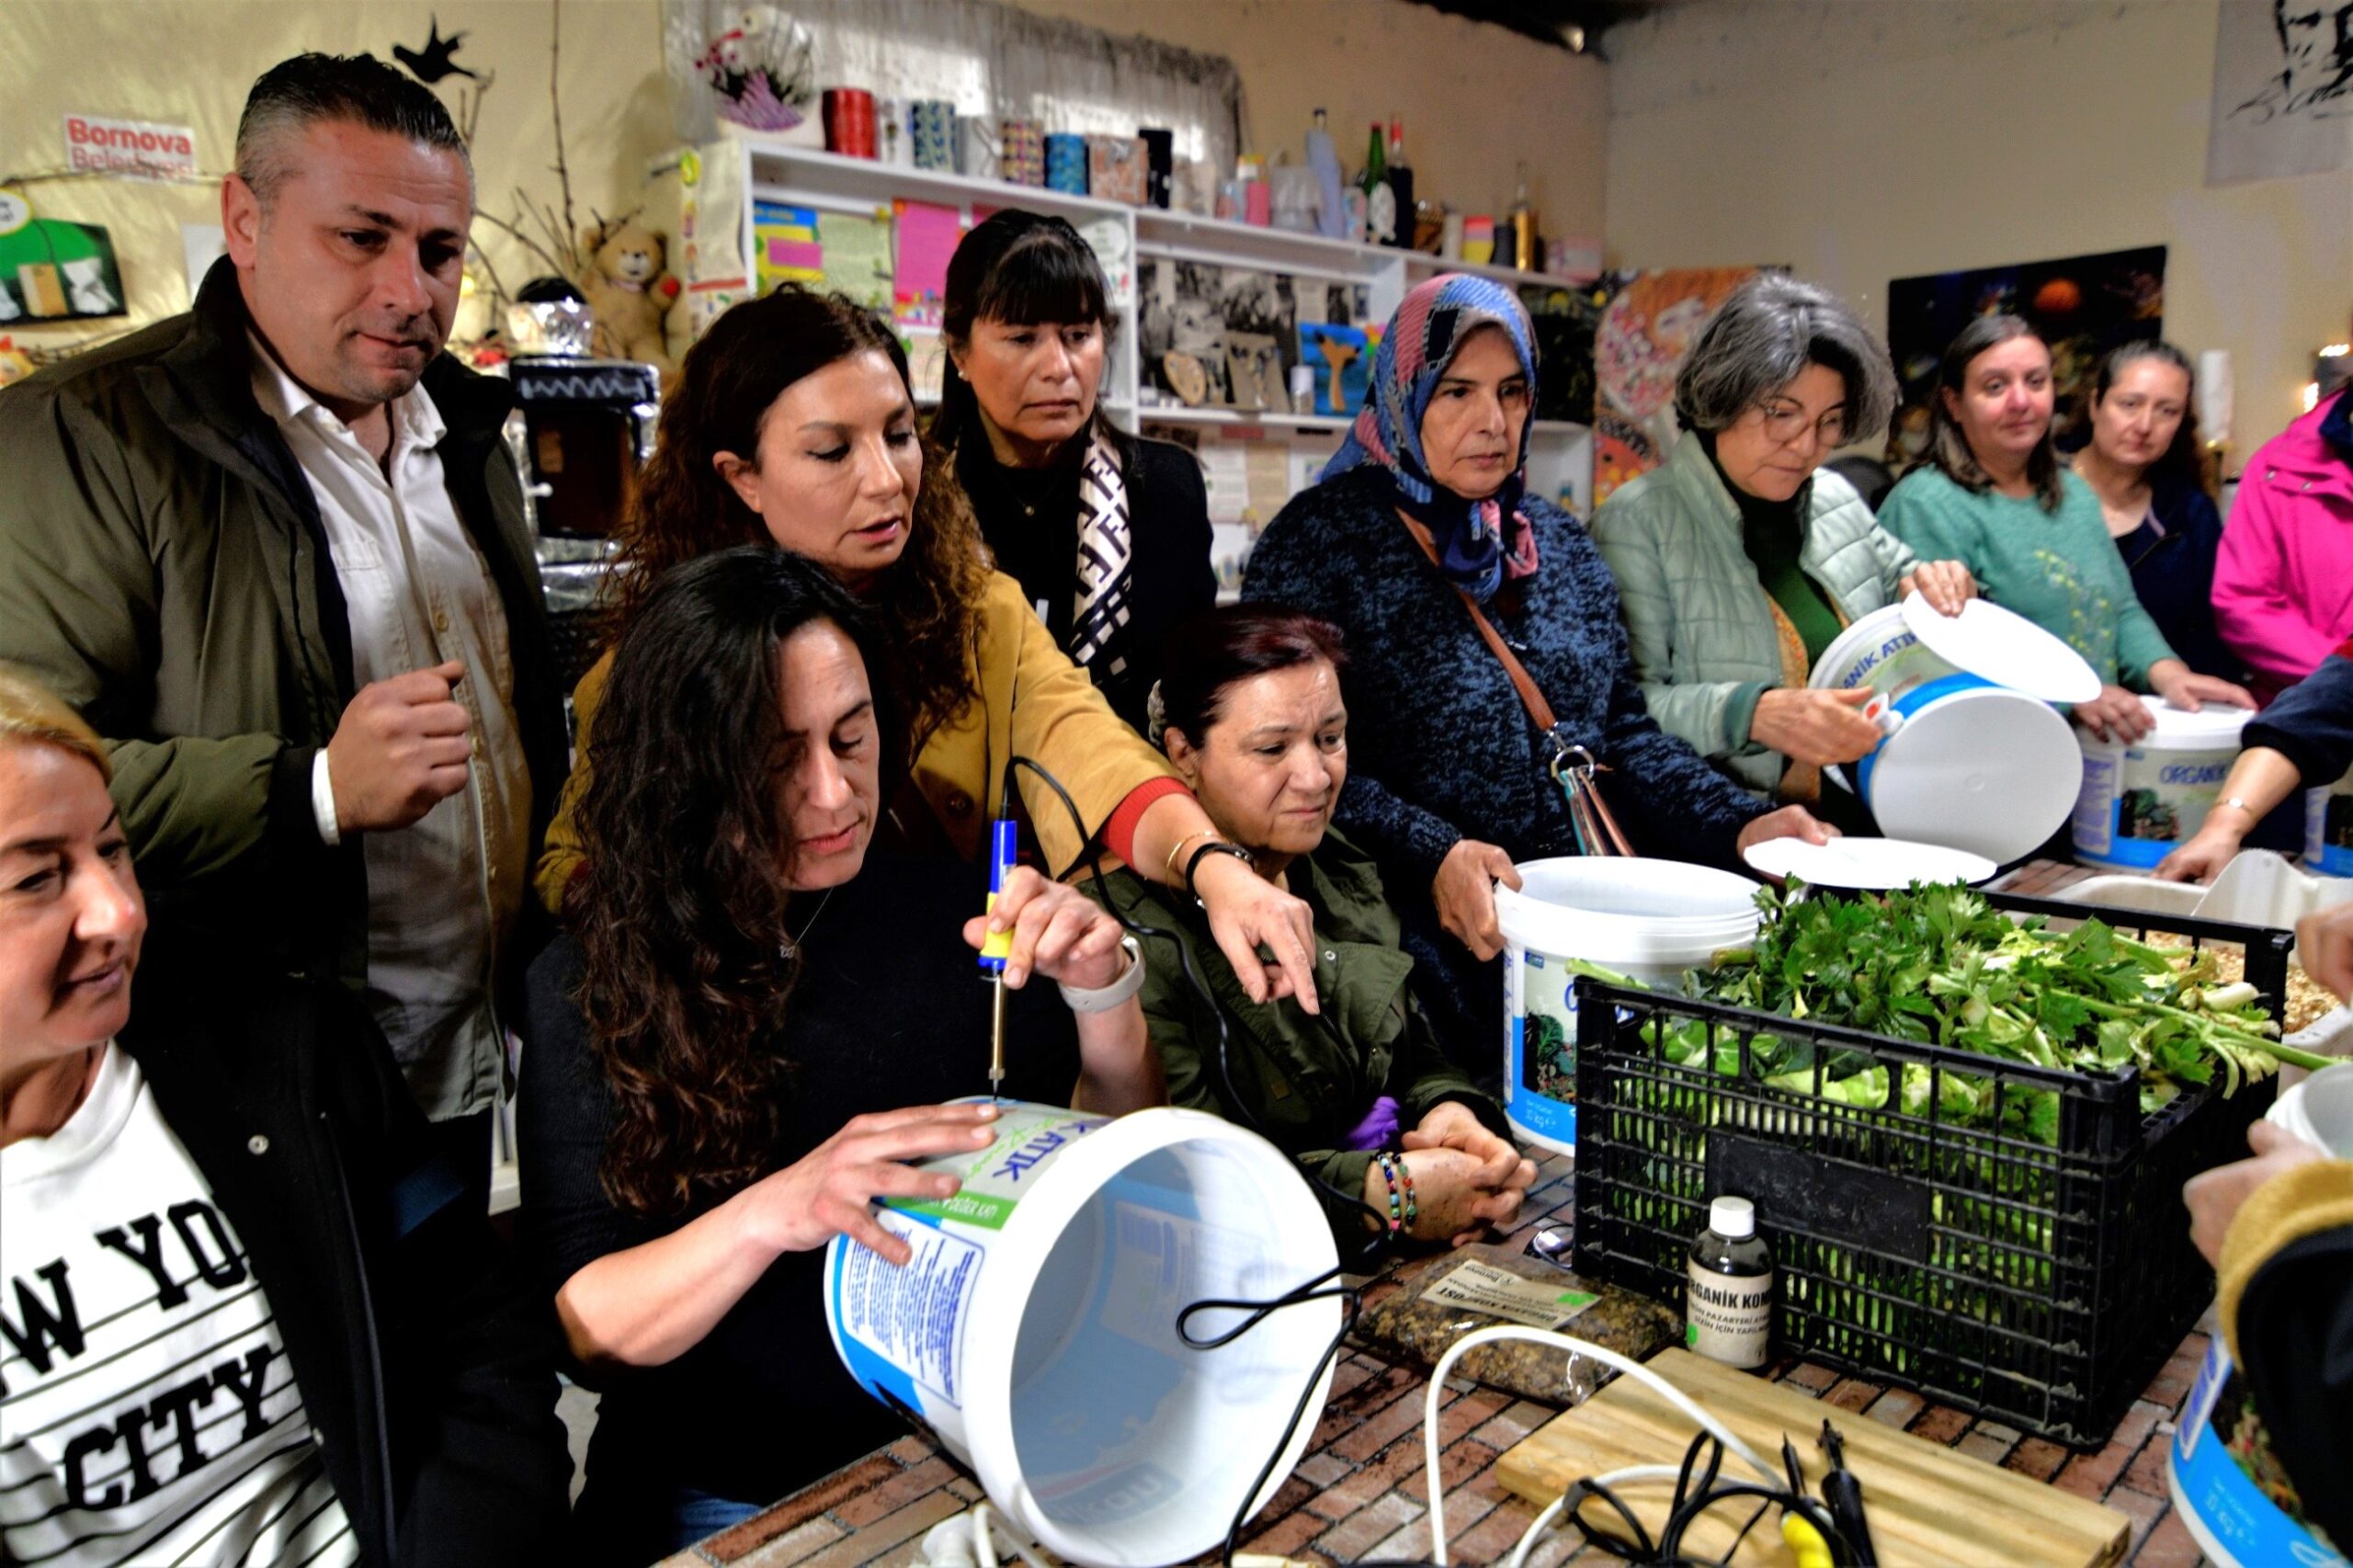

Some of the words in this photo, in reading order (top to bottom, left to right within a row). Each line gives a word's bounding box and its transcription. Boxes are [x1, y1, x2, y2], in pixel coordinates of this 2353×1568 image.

[67, 118, 192, 155] Bornova
[993, 1131, 1066, 1182] ATIK
[0, 1257, 86, 1377] W
[1690, 1279, 1739, 1309] RGANİK
[63, 1344, 273, 1511] CITY
